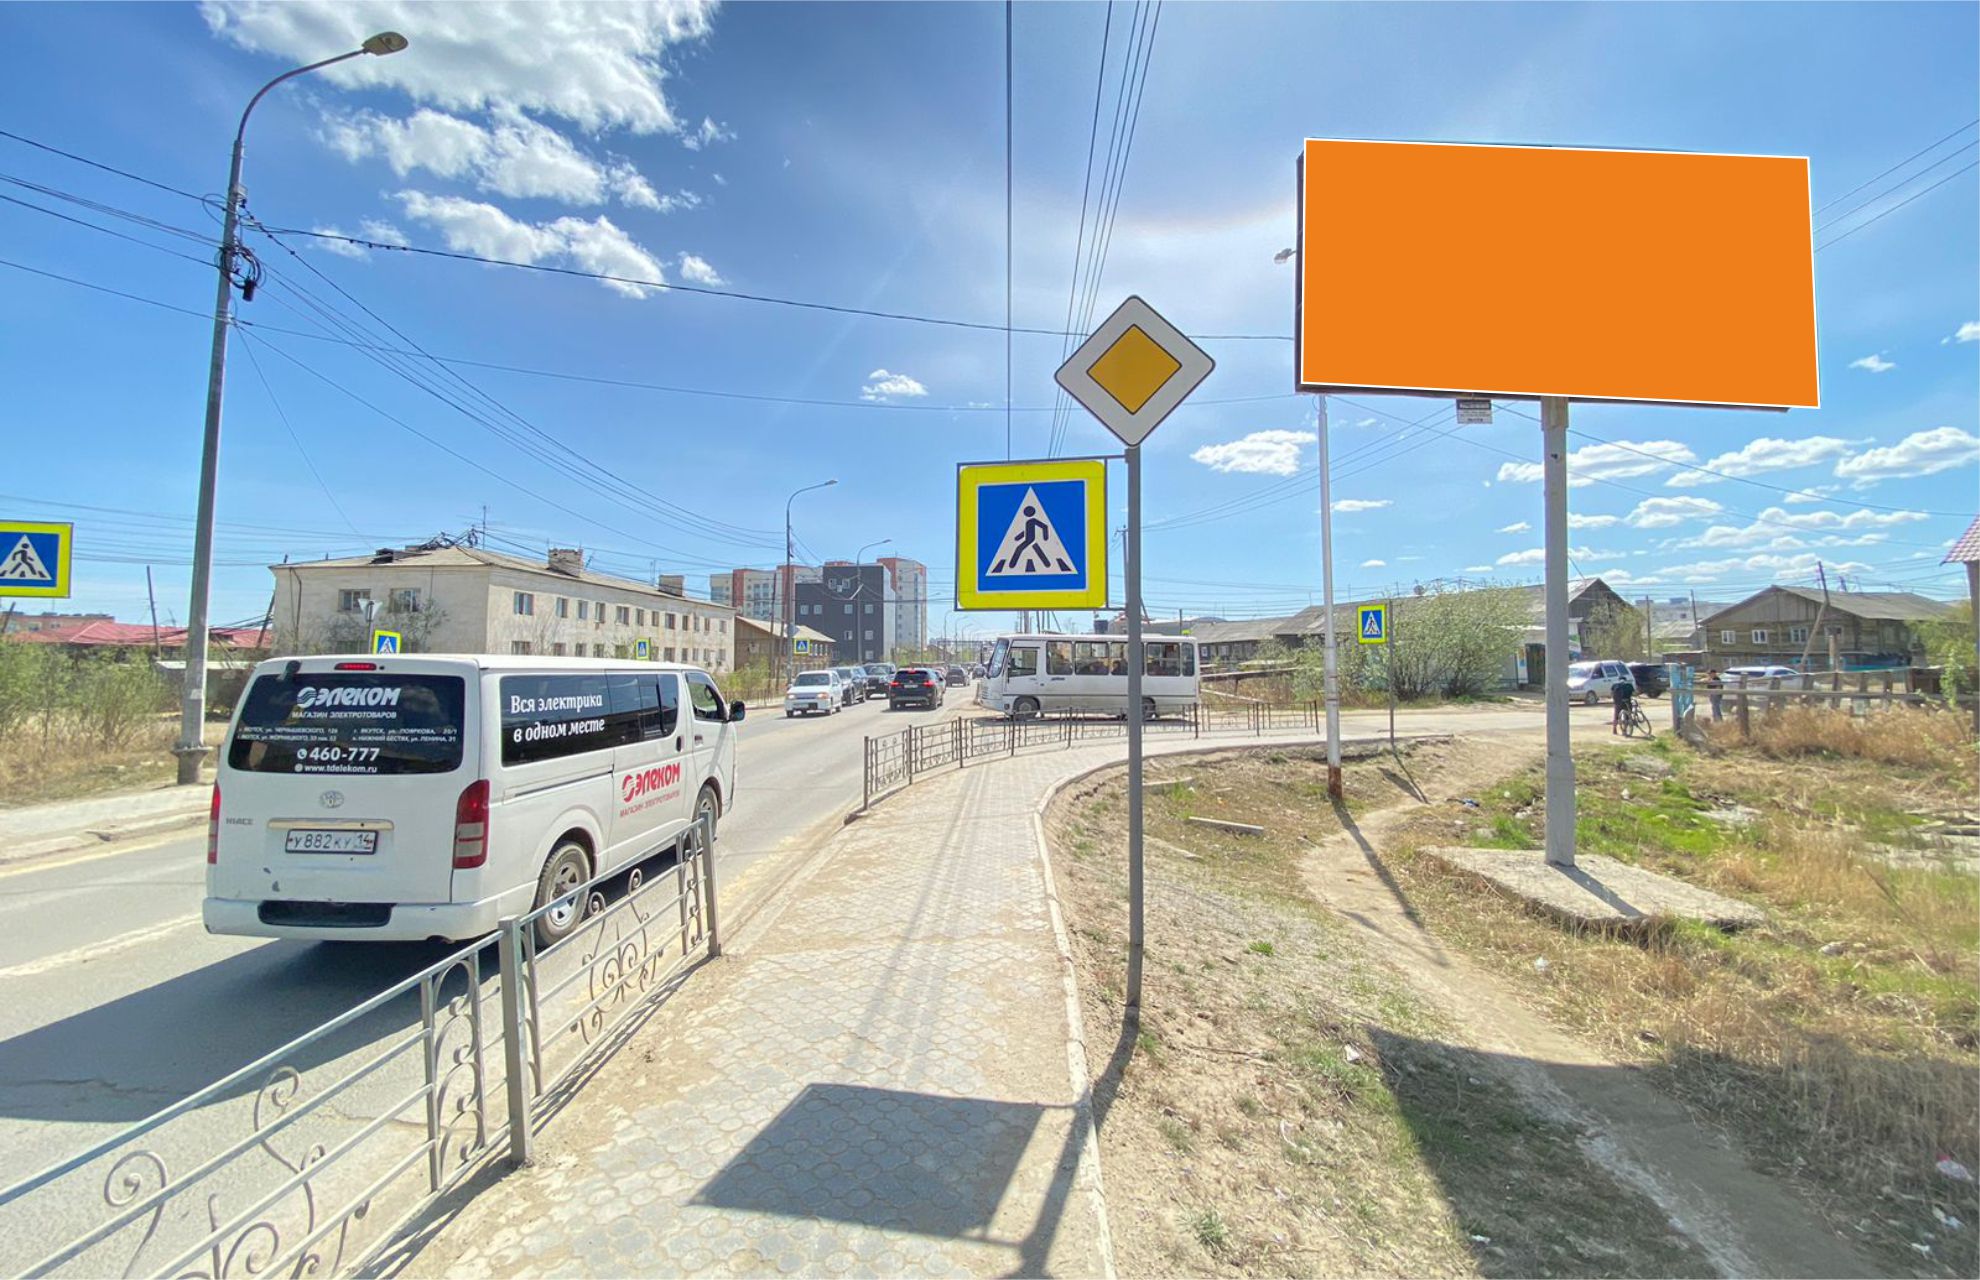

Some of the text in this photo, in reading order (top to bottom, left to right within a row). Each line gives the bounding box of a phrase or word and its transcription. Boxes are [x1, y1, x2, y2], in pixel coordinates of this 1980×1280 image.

[511, 694, 603, 714] Вся электрика
[292, 711, 397, 719] МАГАЗИН ЭЛЕКТРОТОВАРОВ
[513, 719, 605, 743] в одном месте
[309, 746, 380, 762] 460-777
[304, 764, 378, 774] www.tdelekom.ru
